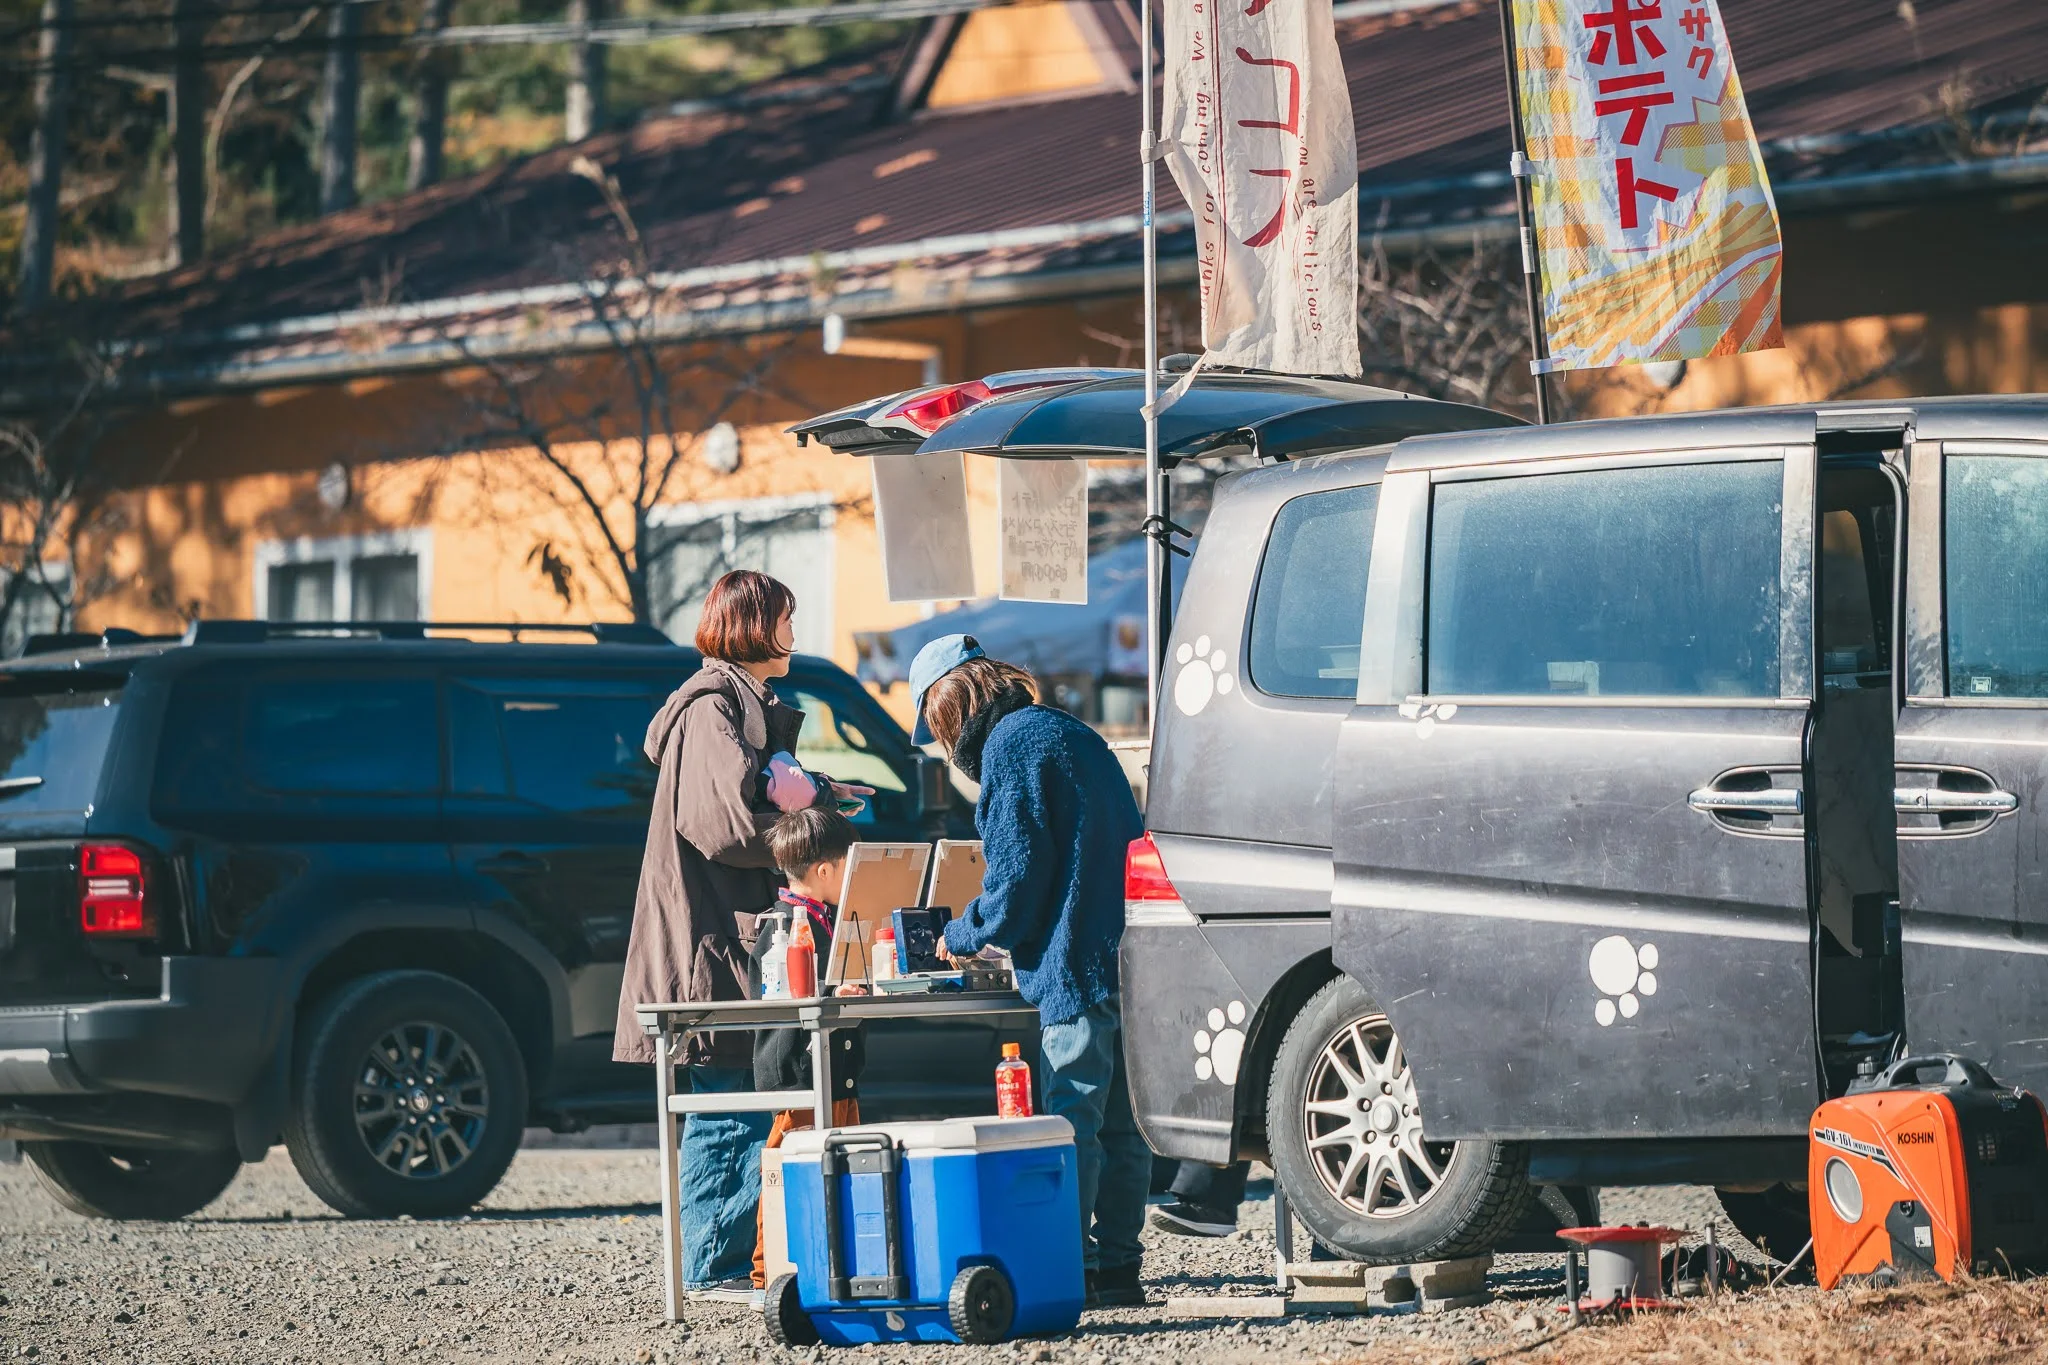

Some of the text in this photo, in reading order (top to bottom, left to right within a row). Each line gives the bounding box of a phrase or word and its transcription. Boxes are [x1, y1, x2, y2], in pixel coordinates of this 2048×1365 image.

[1191, 30, 1204, 61] We
[1678, 0, 1715, 81] サク
[1195, 82, 1211, 174] coming.
[1583, 0, 1676, 230] ポテト
[1203, 191, 1215, 225] for
[1302, 178, 1318, 210] are
[1303, 224, 1322, 340] delicious.
[1897, 1132, 1935, 1145] KOSHIN
